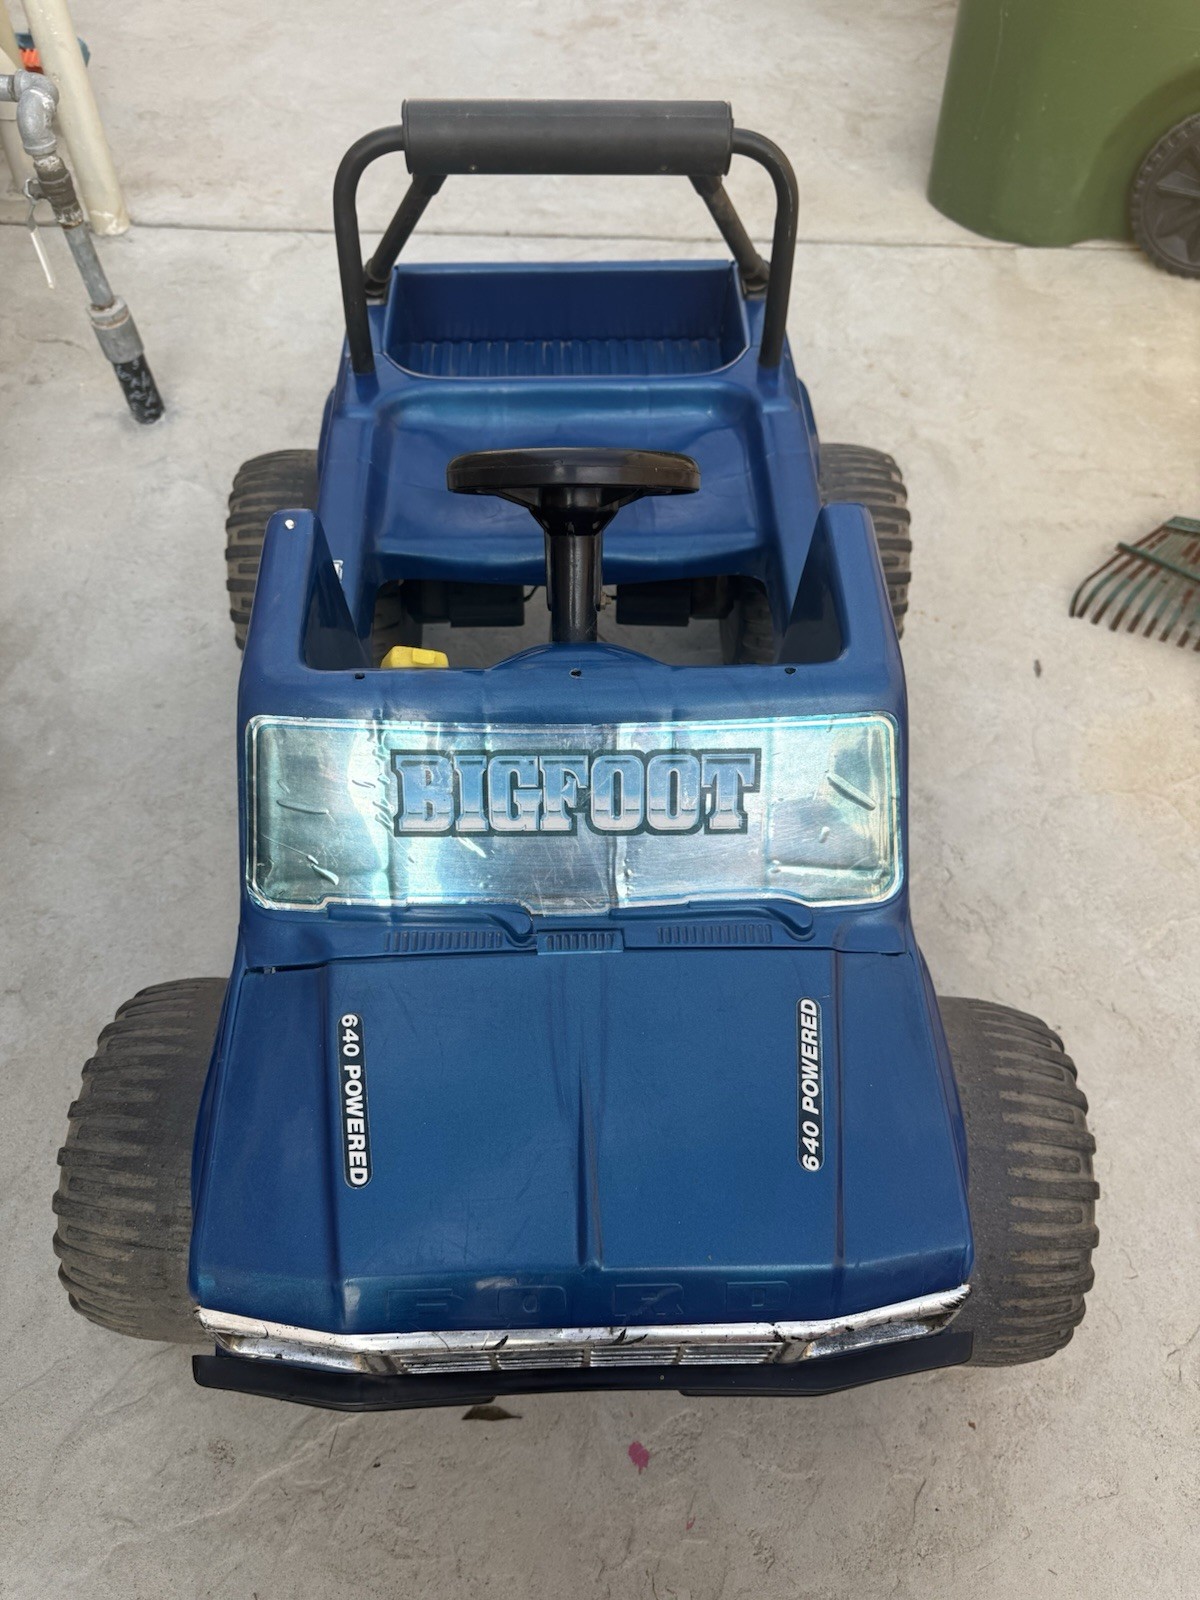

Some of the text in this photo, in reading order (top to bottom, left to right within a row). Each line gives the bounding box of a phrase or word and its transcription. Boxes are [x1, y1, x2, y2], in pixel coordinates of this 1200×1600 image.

[391, 749, 762, 837] BIGFOOT
[341, 1014, 368, 1186] 640 POWERED
[800, 999, 820, 1172] 640 POWERED
[387, 1281, 791, 1323] FORD
